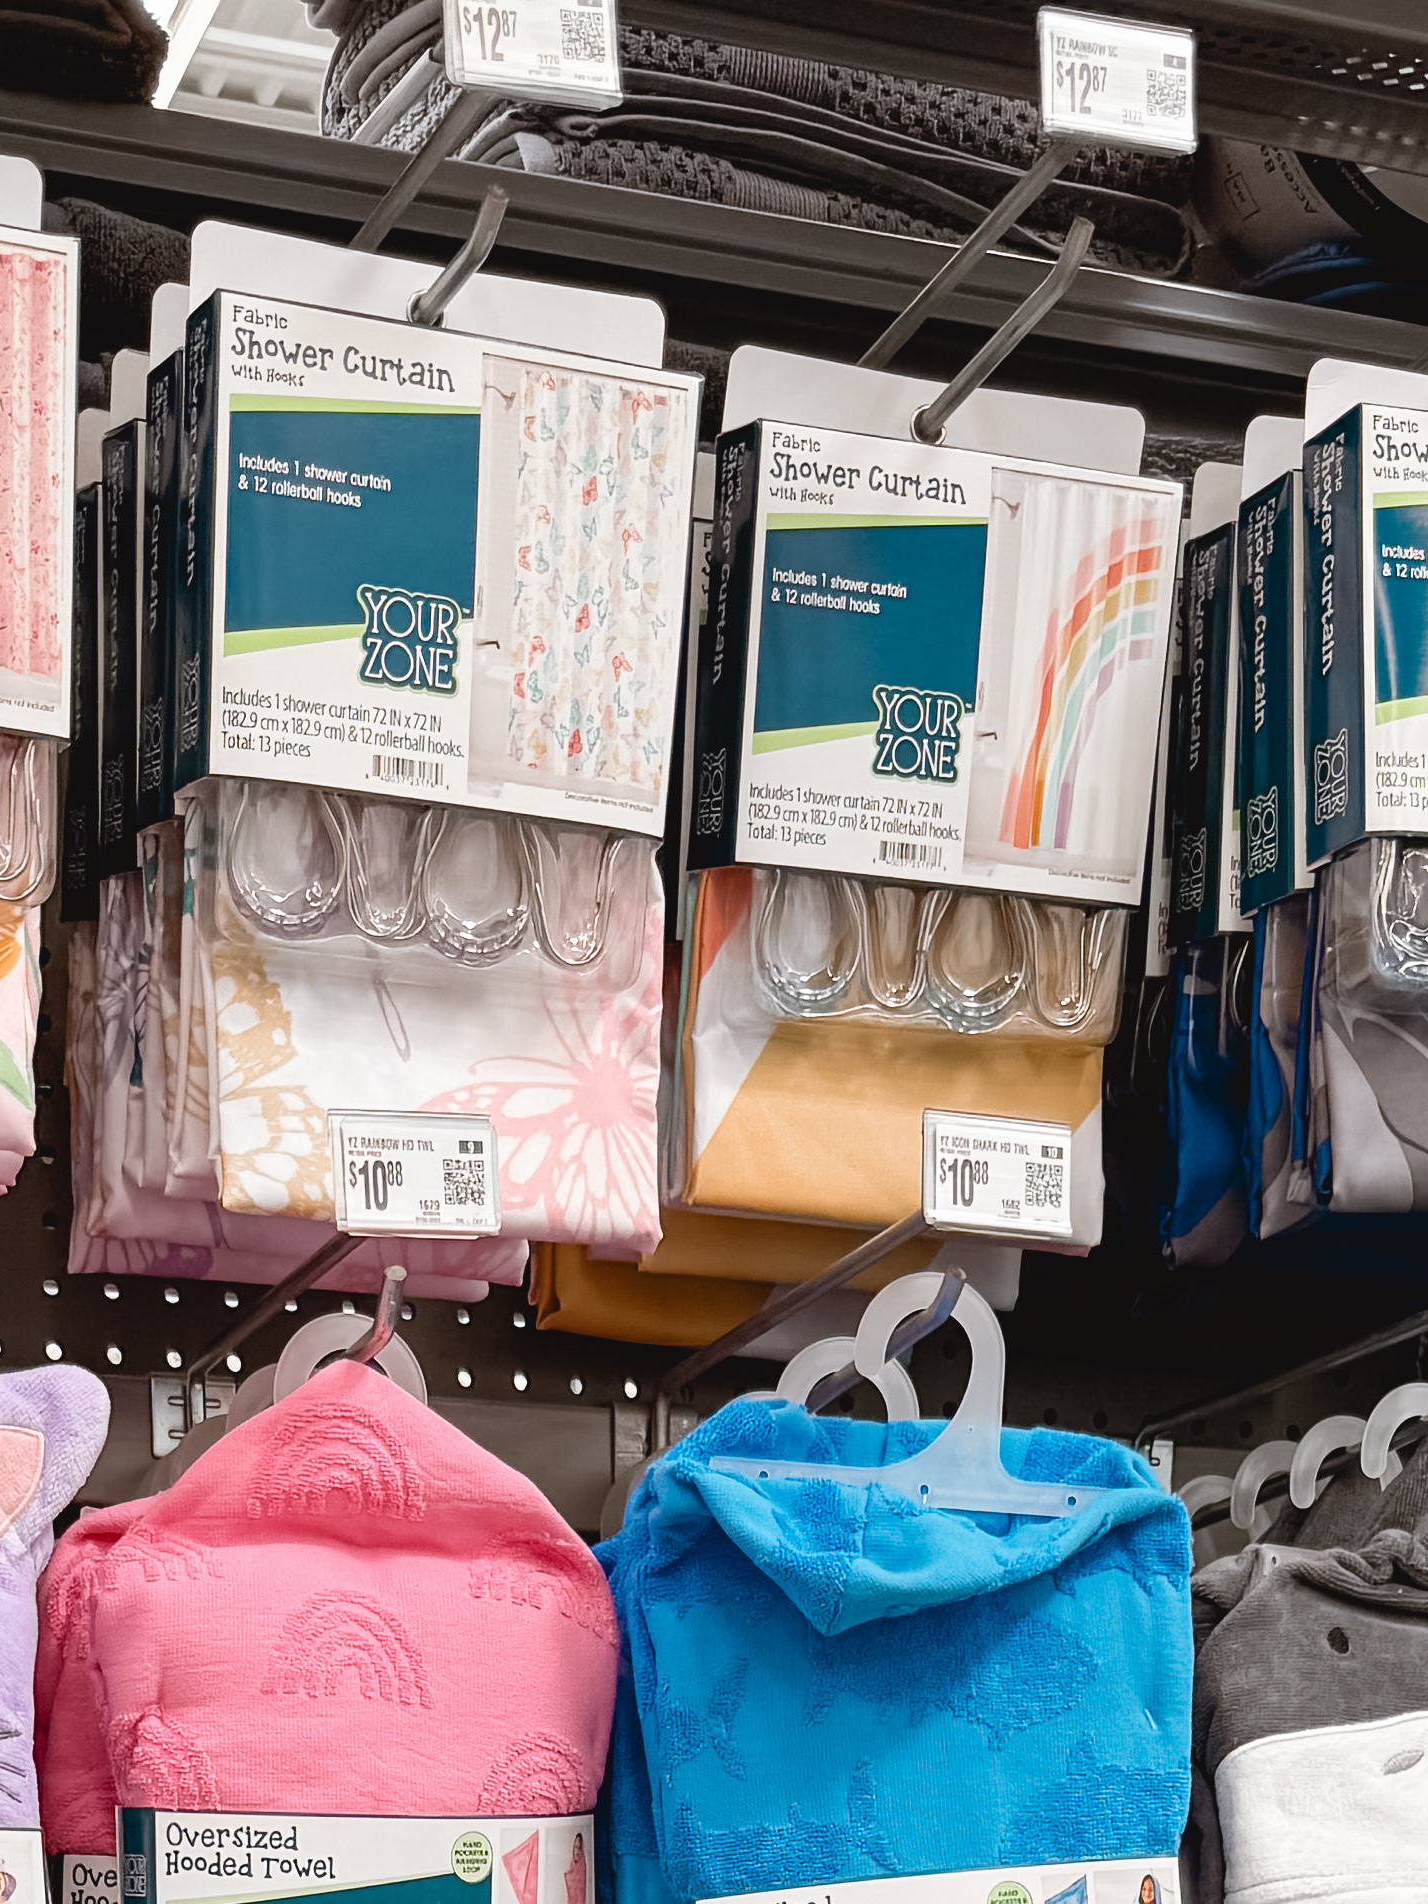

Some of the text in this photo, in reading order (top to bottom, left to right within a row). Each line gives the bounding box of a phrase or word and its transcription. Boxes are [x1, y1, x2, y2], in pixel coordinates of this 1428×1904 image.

[233, 306, 288, 329] Fabric
[232, 328, 455, 393] Shower Curtain
[772, 432, 820, 452] Fabric
[1373, 416, 1419, 433] Fabric
[770, 453, 966, 505] Shower Curtain
[366, 593, 454, 644] YOUR
[366, 639, 453, 689] ZONE
[880, 691, 958, 737] YOUR
[878, 734, 955, 778] ZONE
[166, 1823, 298, 1851] Oversized
[166, 1853, 336, 1880] Hooded Towel
